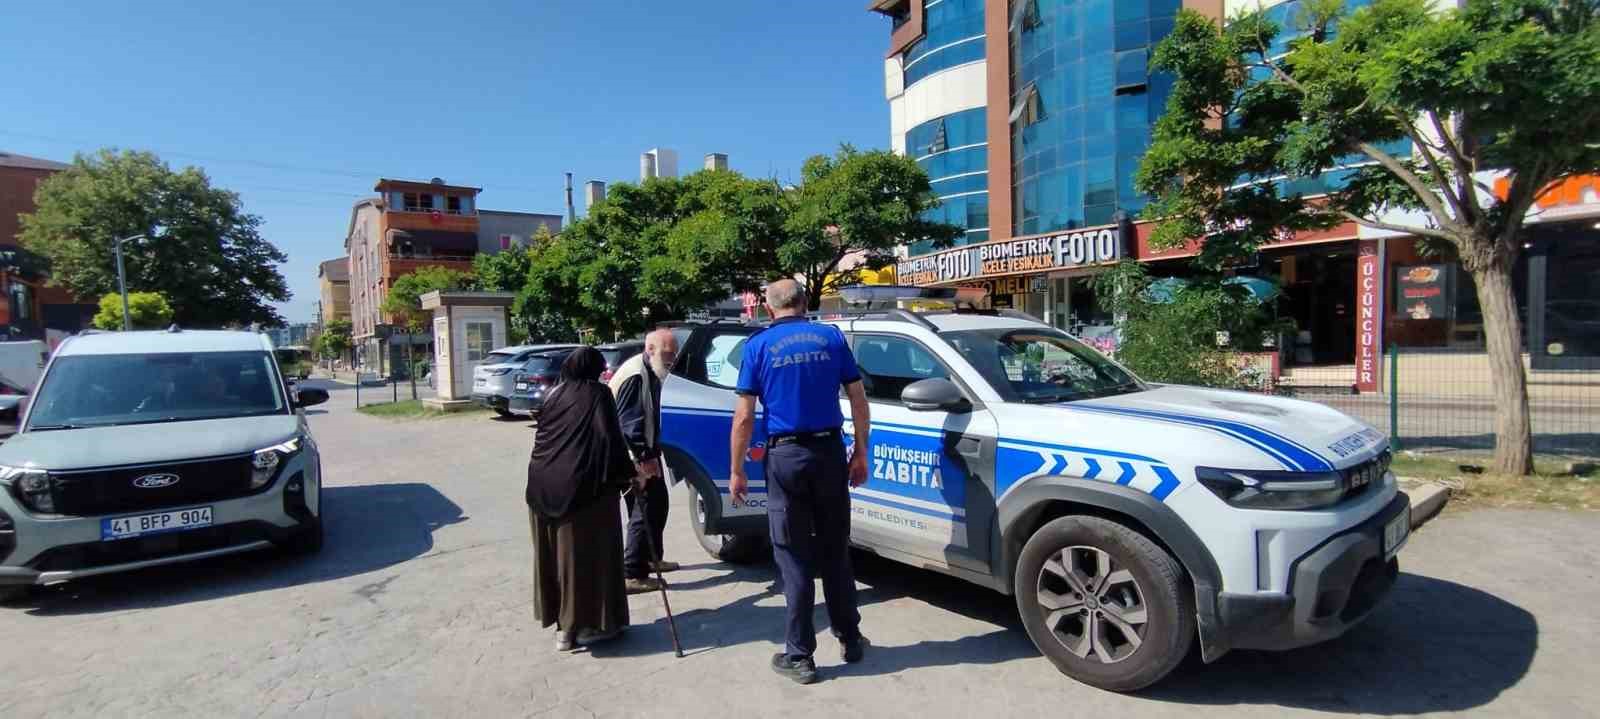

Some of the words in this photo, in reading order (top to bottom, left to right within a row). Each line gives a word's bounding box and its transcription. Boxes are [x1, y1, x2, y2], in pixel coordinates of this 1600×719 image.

[1054, 229, 1113, 266] FOTO
[937, 250, 970, 281] FOTO
[981, 260, 1007, 274] ACELE
[772, 350, 832, 368] ZABITA
[873, 443, 941, 466] BÜYÜKŞEHİR
[142, 476, 171, 486] Ford
[873, 458, 944, 490] ZABITA
[113, 519, 131, 533] 41
[140, 514, 171, 530] BFP
[180, 509, 210, 525] 904
